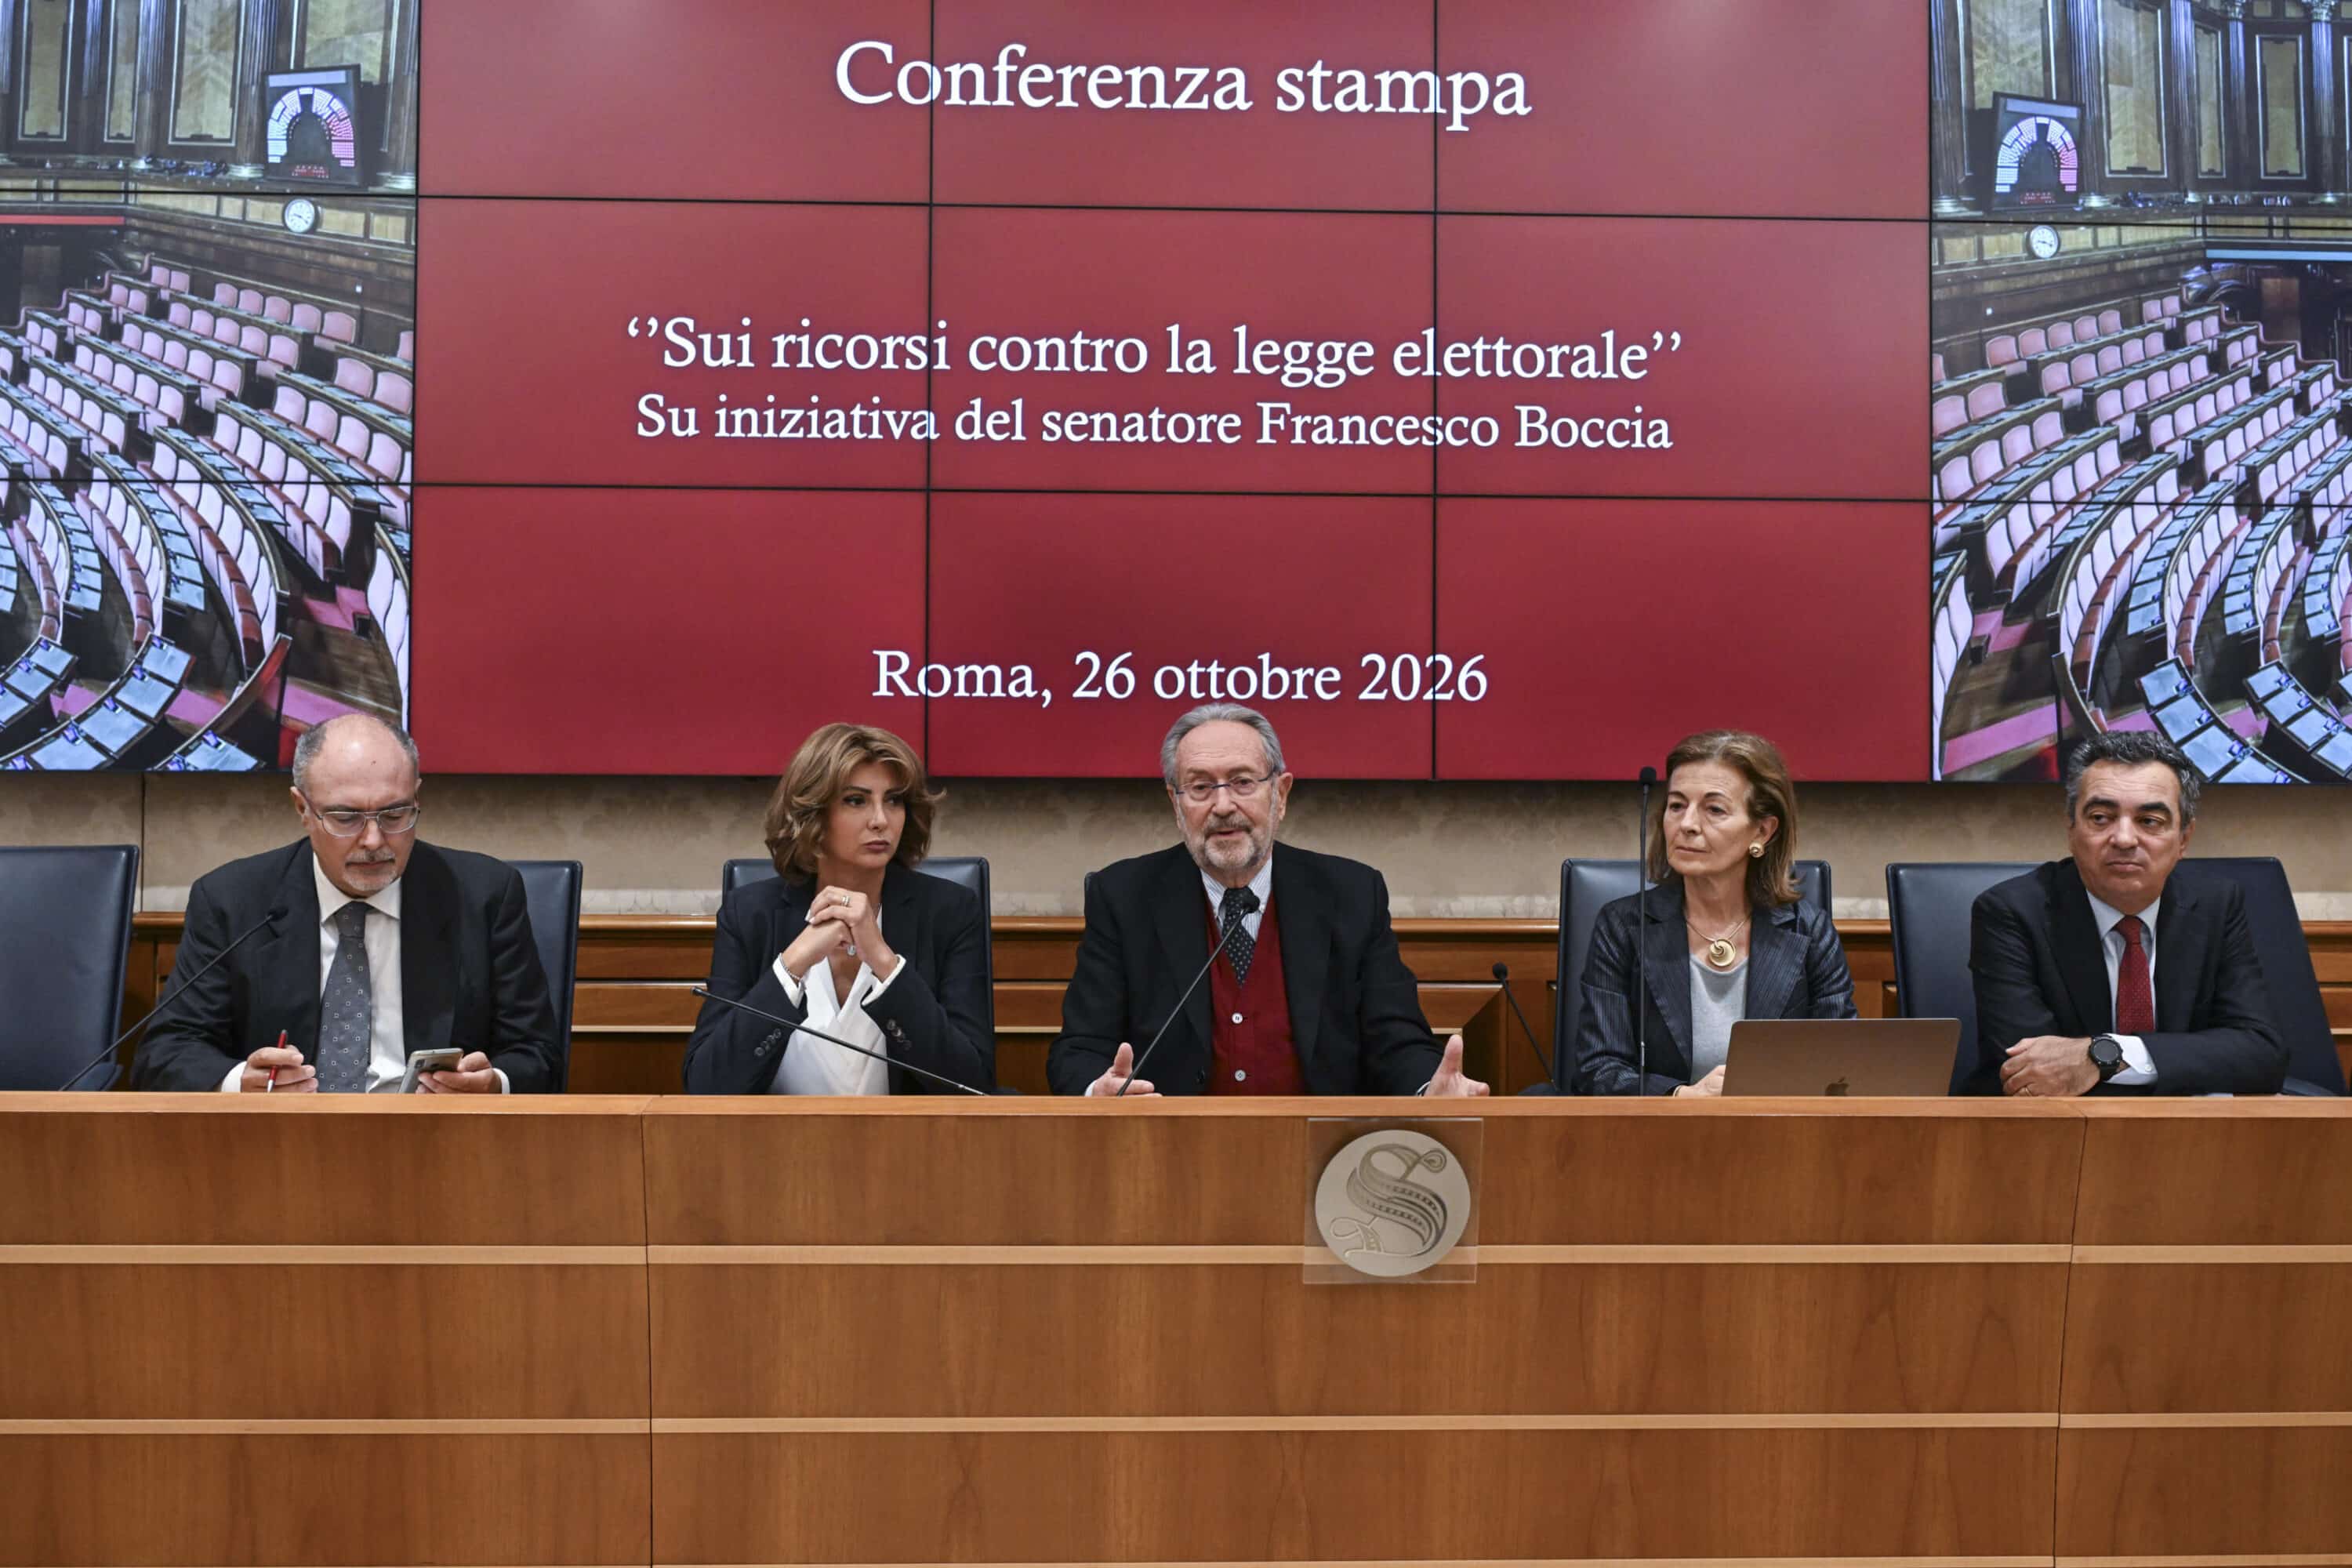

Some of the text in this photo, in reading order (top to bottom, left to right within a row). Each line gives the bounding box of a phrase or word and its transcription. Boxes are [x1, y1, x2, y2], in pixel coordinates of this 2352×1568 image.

[836, 41, 1533, 132] Conferenza stampa
[771, 318, 951, 371] ricorsi
[968, 330, 1148, 373] contro
[1166, 323, 1217, 374] la
[1232, 325, 1374, 388] legge
[637, 394, 1674, 448] Su iniziativa del senatore Francesco Boccia
[872, 650, 1487, 708] Roma, 26 ottobre 2026
